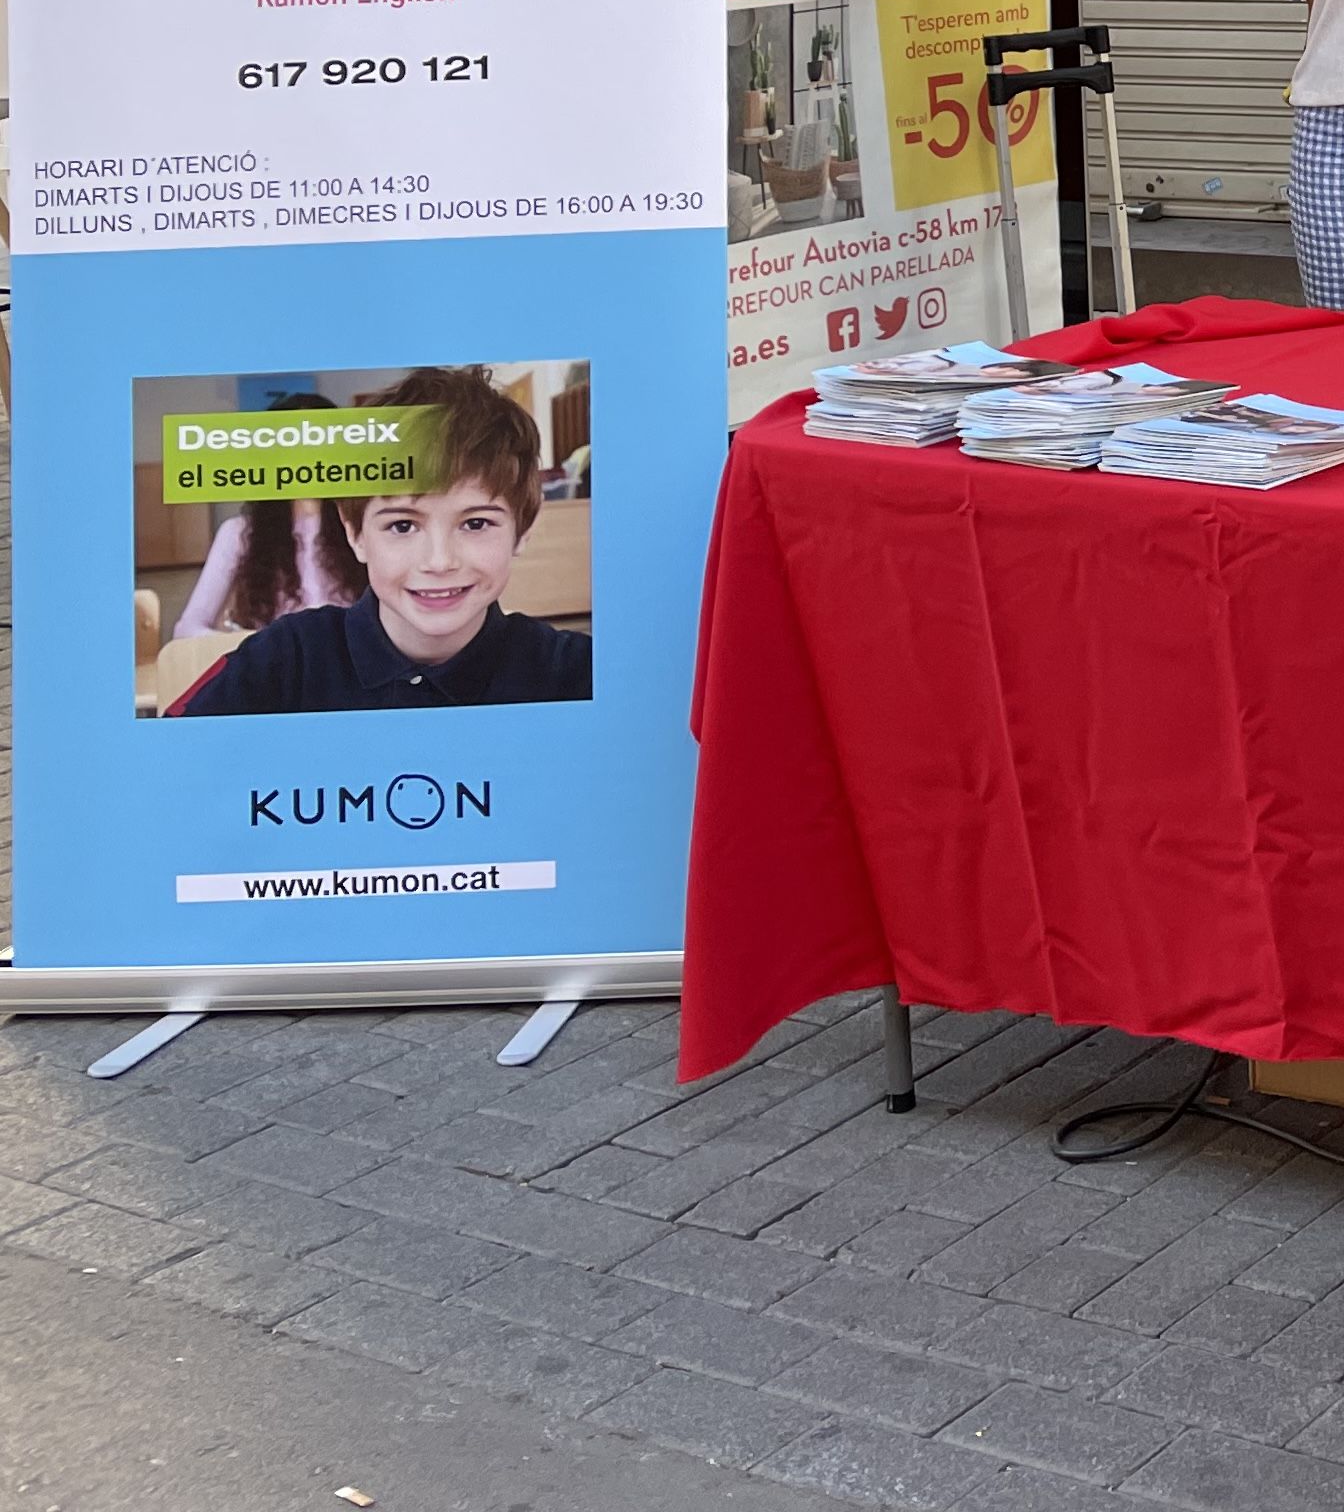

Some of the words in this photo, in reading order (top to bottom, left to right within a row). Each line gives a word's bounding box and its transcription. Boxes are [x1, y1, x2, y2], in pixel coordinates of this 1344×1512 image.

[901, 10, 989, 34] T'esperem
[996, 4, 1029, 25] amb
[905, 34, 985, 60] descomp
[238, 62, 308, 90] 617
[322, 58, 407, 86] 920
[422, 55, 491, 82] 121
[896, 116, 916, 128] fins
[35, 159, 123, 179] HORARI
[35, 186, 138, 208] DIMARTS
[160, 182, 243, 203] DIJOUS
[250, 180, 281, 200] DE
[288, 177, 342, 199] 11:00
[348, 177, 364, 196] A
[370, 174, 430, 194] 14:30
[35, 214, 132, 236] DILLUNS
[154, 209, 256, 232] DIMARTS
[276, 203, 397, 227] DIMECRES
[419, 198, 507, 221] DIJOUS
[516, 197, 548, 217] DE
[556, 194, 614, 215] 16:00
[619, 193, 636, 212] A
[642, 191, 703, 211] 19:30
[803, 231, 891, 267] Autovia
[898, 221, 942, 248] c-58
[947, 209, 978, 236] km
[727, 280, 813, 319] REFOUR
[819, 270, 865, 296] CAN
[871, 245, 974, 286] PARELLADA
[727, 335, 790, 368] a.es
[177, 418, 400, 452] Descobreix
[178, 463, 203, 488] el
[212, 463, 265, 487] seu
[276, 456, 414, 491] potencial
[249, 773, 492, 830] KUMON
[243, 866, 500, 898] www.kumon.cat
